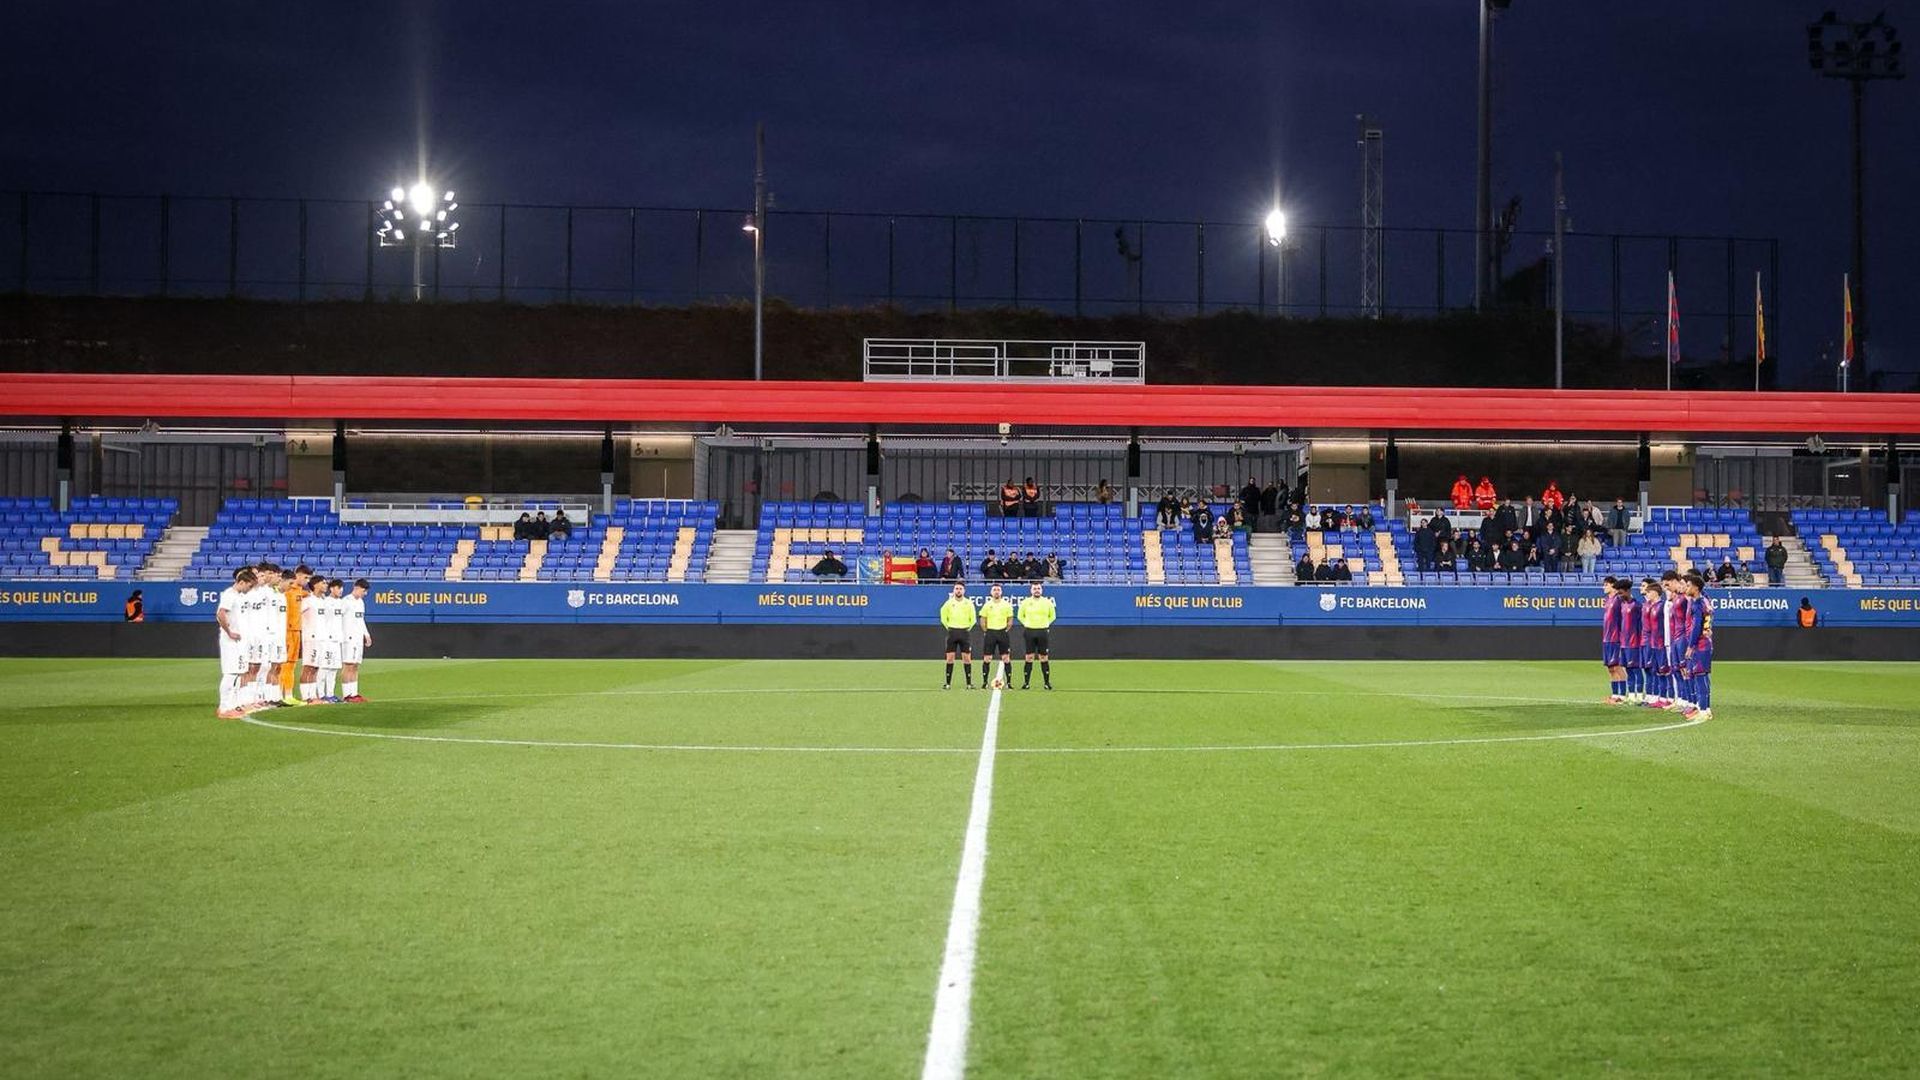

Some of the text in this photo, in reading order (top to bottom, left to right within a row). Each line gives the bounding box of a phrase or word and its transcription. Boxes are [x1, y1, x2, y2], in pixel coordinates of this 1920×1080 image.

[13, 592, 40, 606] QUE
[43, 592, 61, 604] UN
[64, 592, 98, 604] CLUB
[202, 592, 218, 604] FC
[375, 590, 488, 606] MÉS QUE UN CLUB
[588, 593, 679, 606] FC BARCELONA
[758, 592, 869, 608] MÉS QUE UN CLUB
[969, 595, 984, 607] FC
[1135, 594, 1243, 610] MÉS QUE UN CLUB
[1340, 597, 1427, 609] FC BARCELONA
[1503, 595, 1529, 609] MÉS
[1531, 597, 1556, 611] QUE
[1558, 597, 1576, 609] UN
[1721, 598, 1789, 610] BARCELONA
[1860, 596, 1886, 611] MÉS
[1887, 599, 1912, 613] QUE
